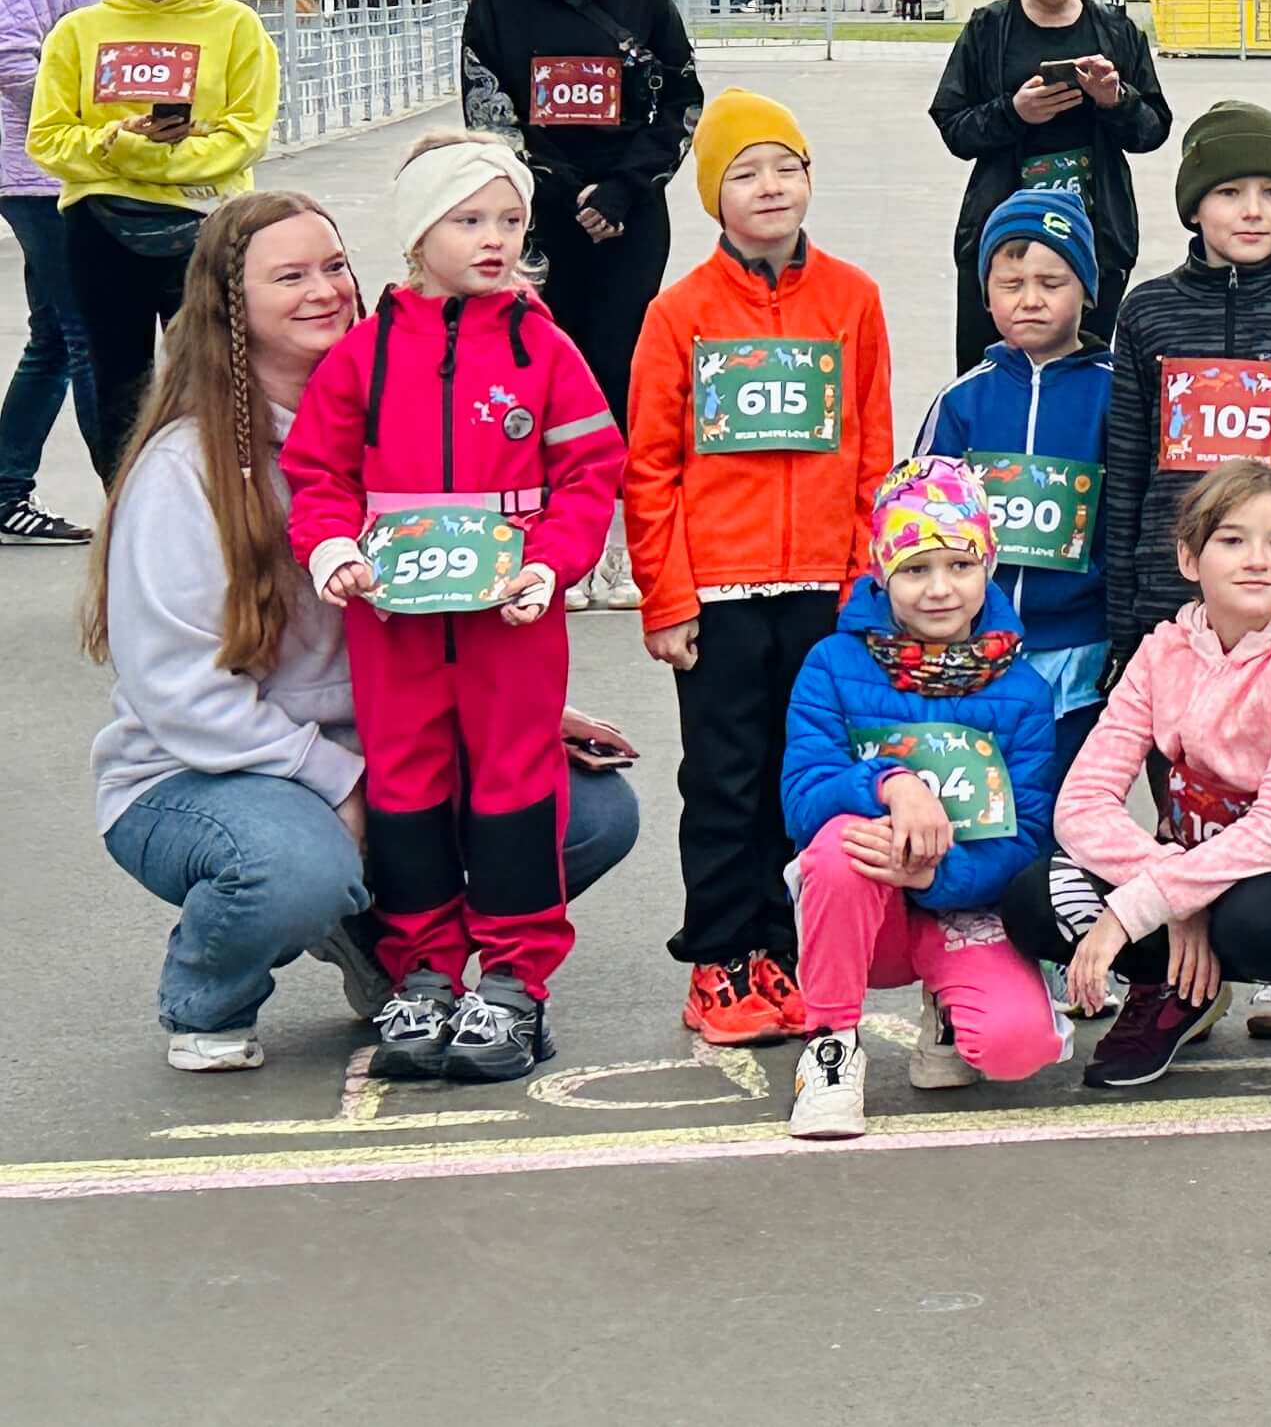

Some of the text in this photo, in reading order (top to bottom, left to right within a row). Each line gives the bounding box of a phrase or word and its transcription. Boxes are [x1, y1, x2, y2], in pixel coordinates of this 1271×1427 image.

[121, 64, 170, 84] 109
[552, 83, 604, 105] 086
[737, 381, 808, 416] 615
[1199, 405, 1271, 440] 105
[987, 495, 1062, 534] 590
[392, 546, 479, 586] 599
